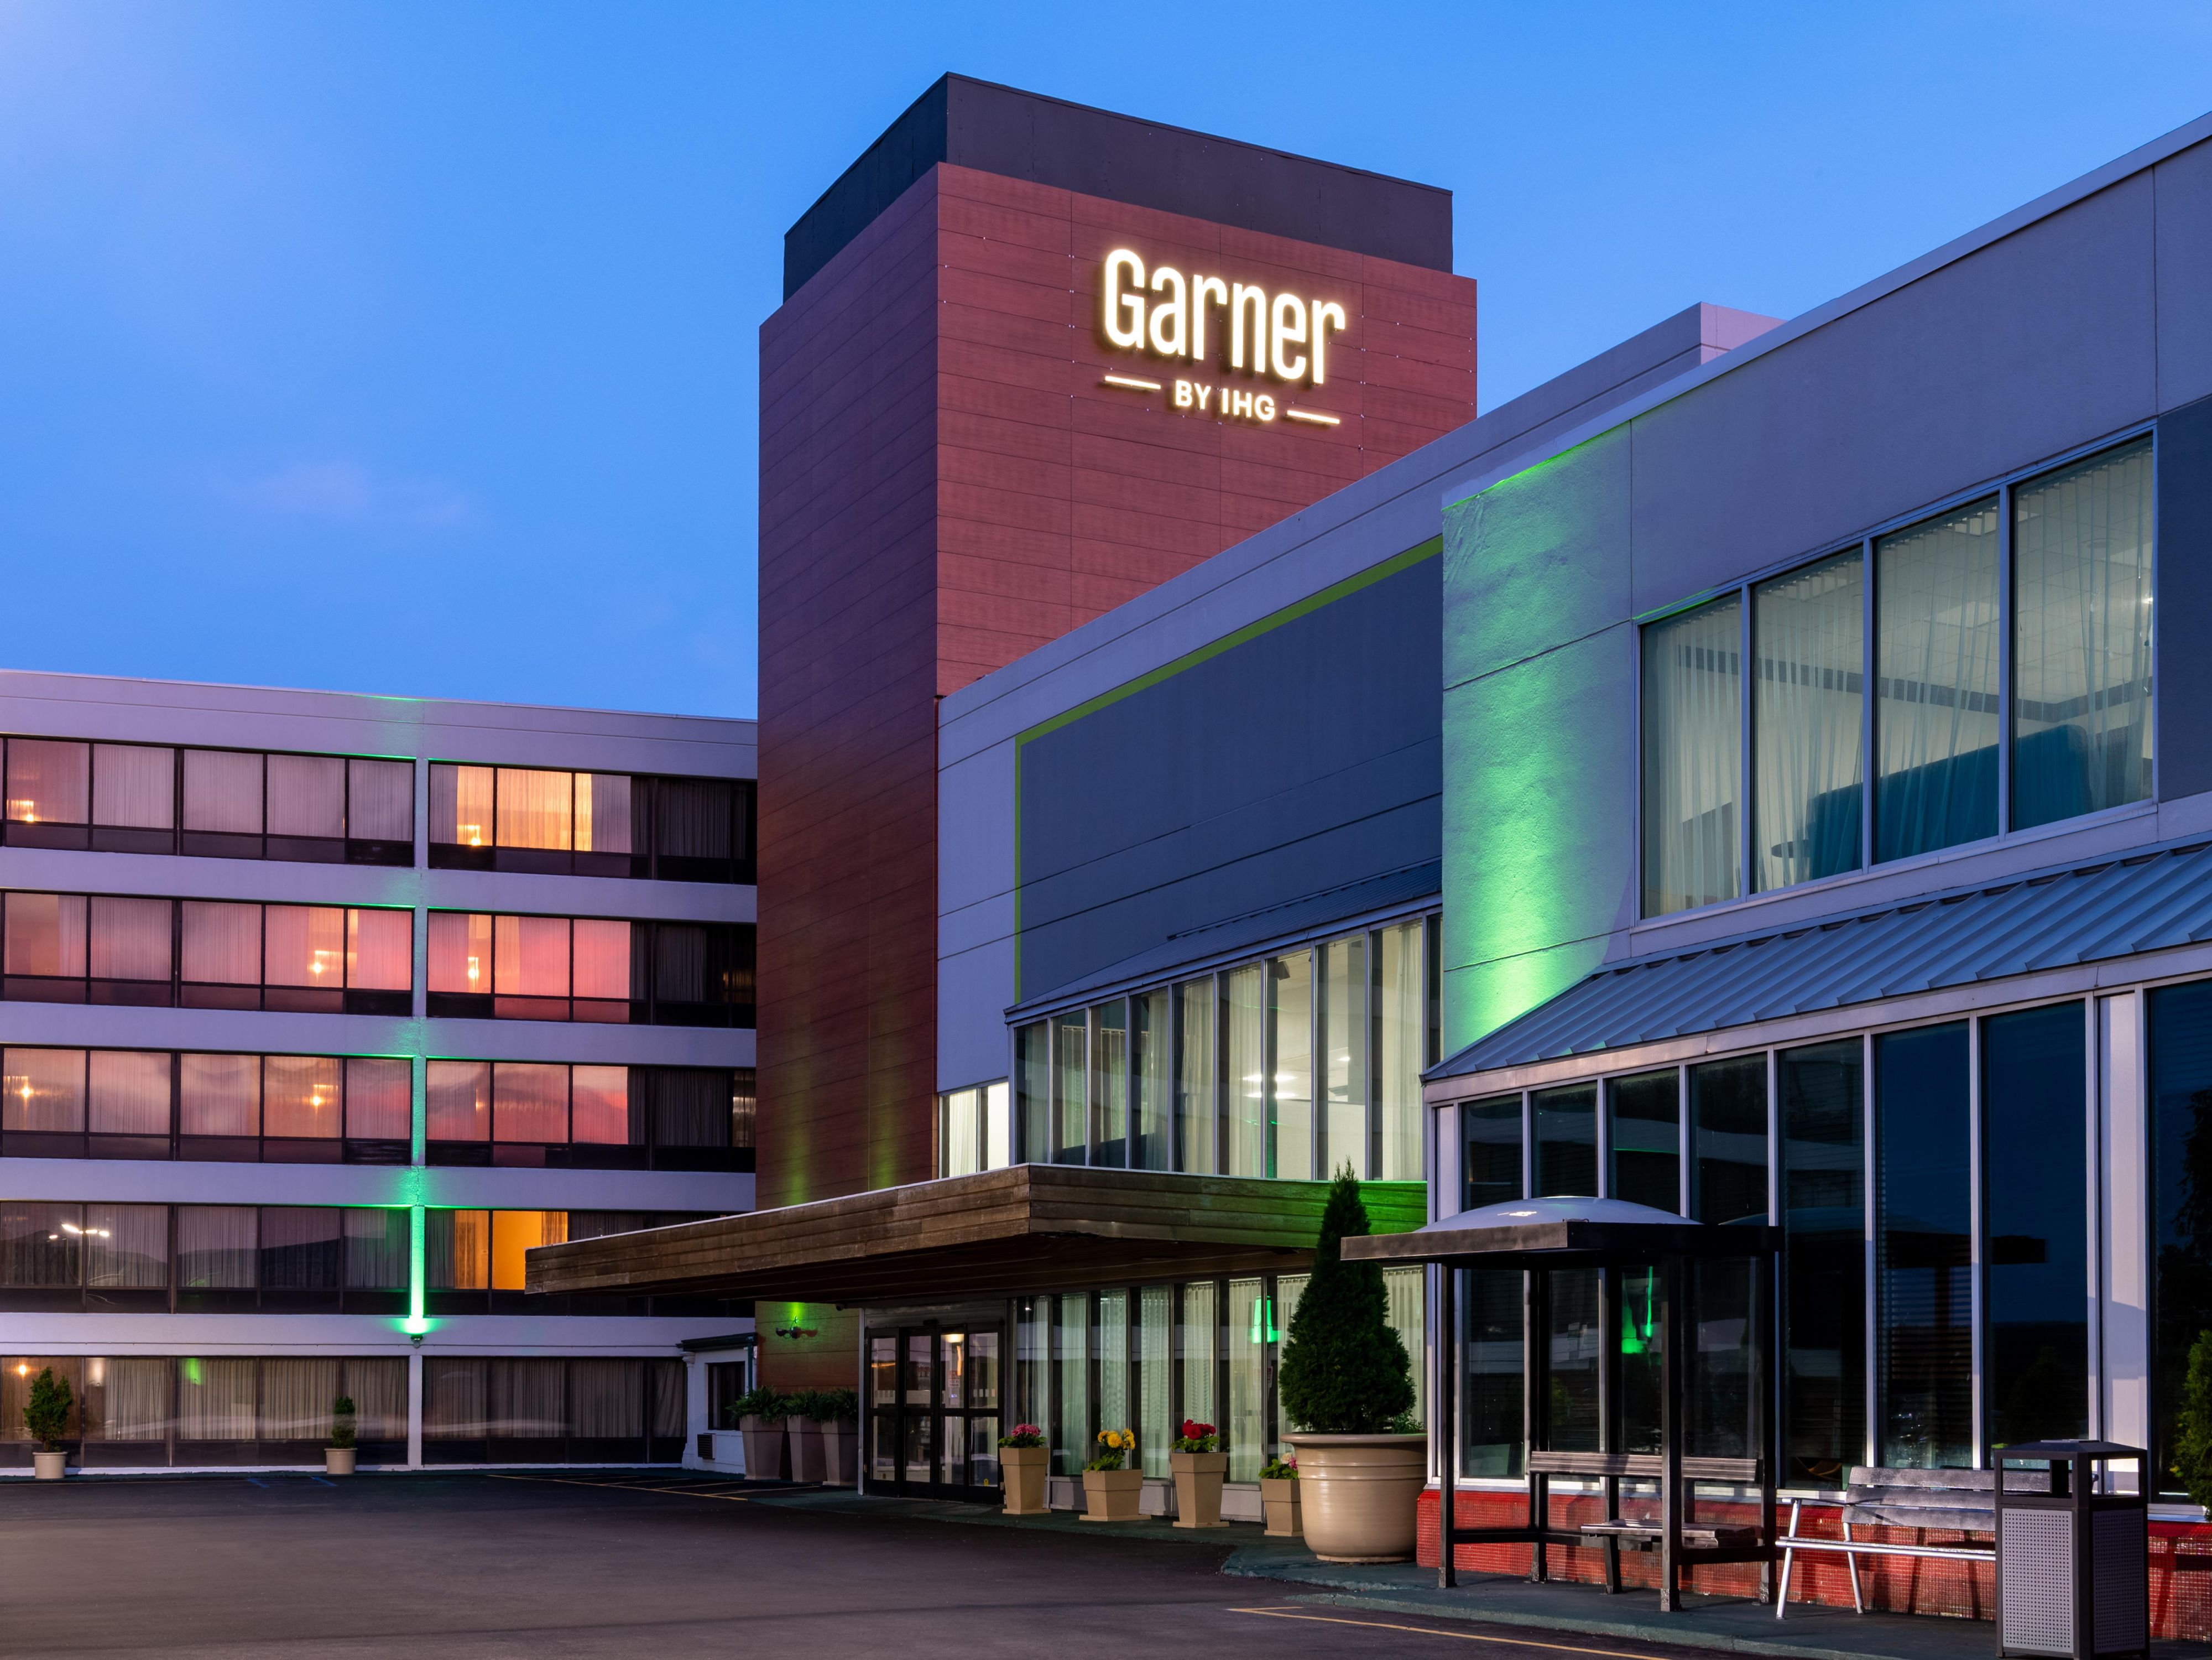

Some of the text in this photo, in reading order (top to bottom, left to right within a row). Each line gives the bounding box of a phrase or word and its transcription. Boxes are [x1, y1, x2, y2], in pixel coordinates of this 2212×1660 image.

[1104, 248, 1346, 384] Garner
[1175, 379, 1276, 421] BY IHG
